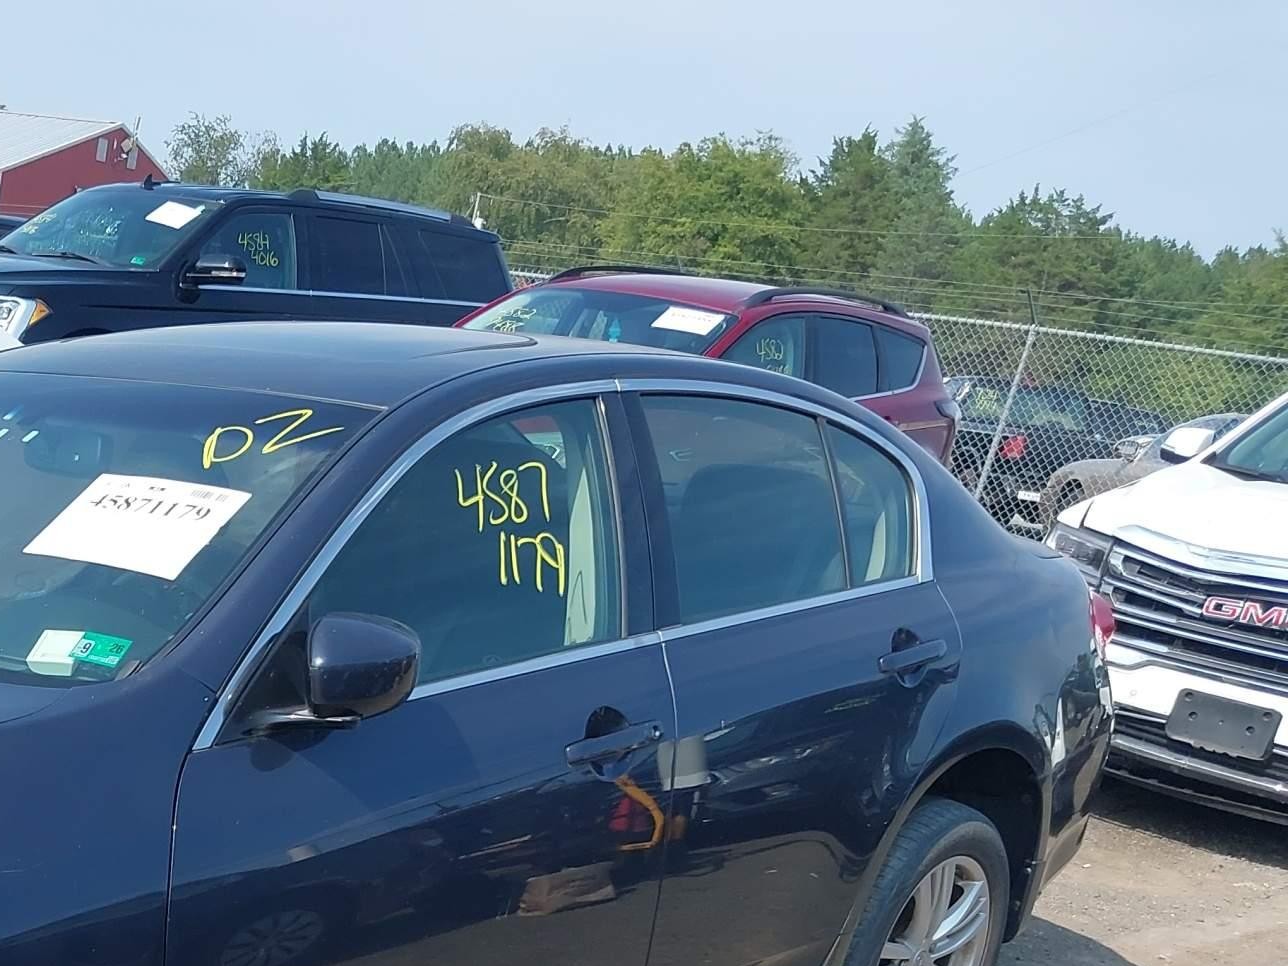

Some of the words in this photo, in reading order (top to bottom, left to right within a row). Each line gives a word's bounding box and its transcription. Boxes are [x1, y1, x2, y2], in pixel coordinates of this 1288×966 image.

[251, 251, 279, 267] 4016
[89, 493, 212, 521] 45871179
[454, 460, 551, 533] 4587
[499, 529, 566, 598] 1179
[1202, 595, 1288, 630] GM
[80, 641, 93, 654] 9
[108, 642, 126, 655] 26
